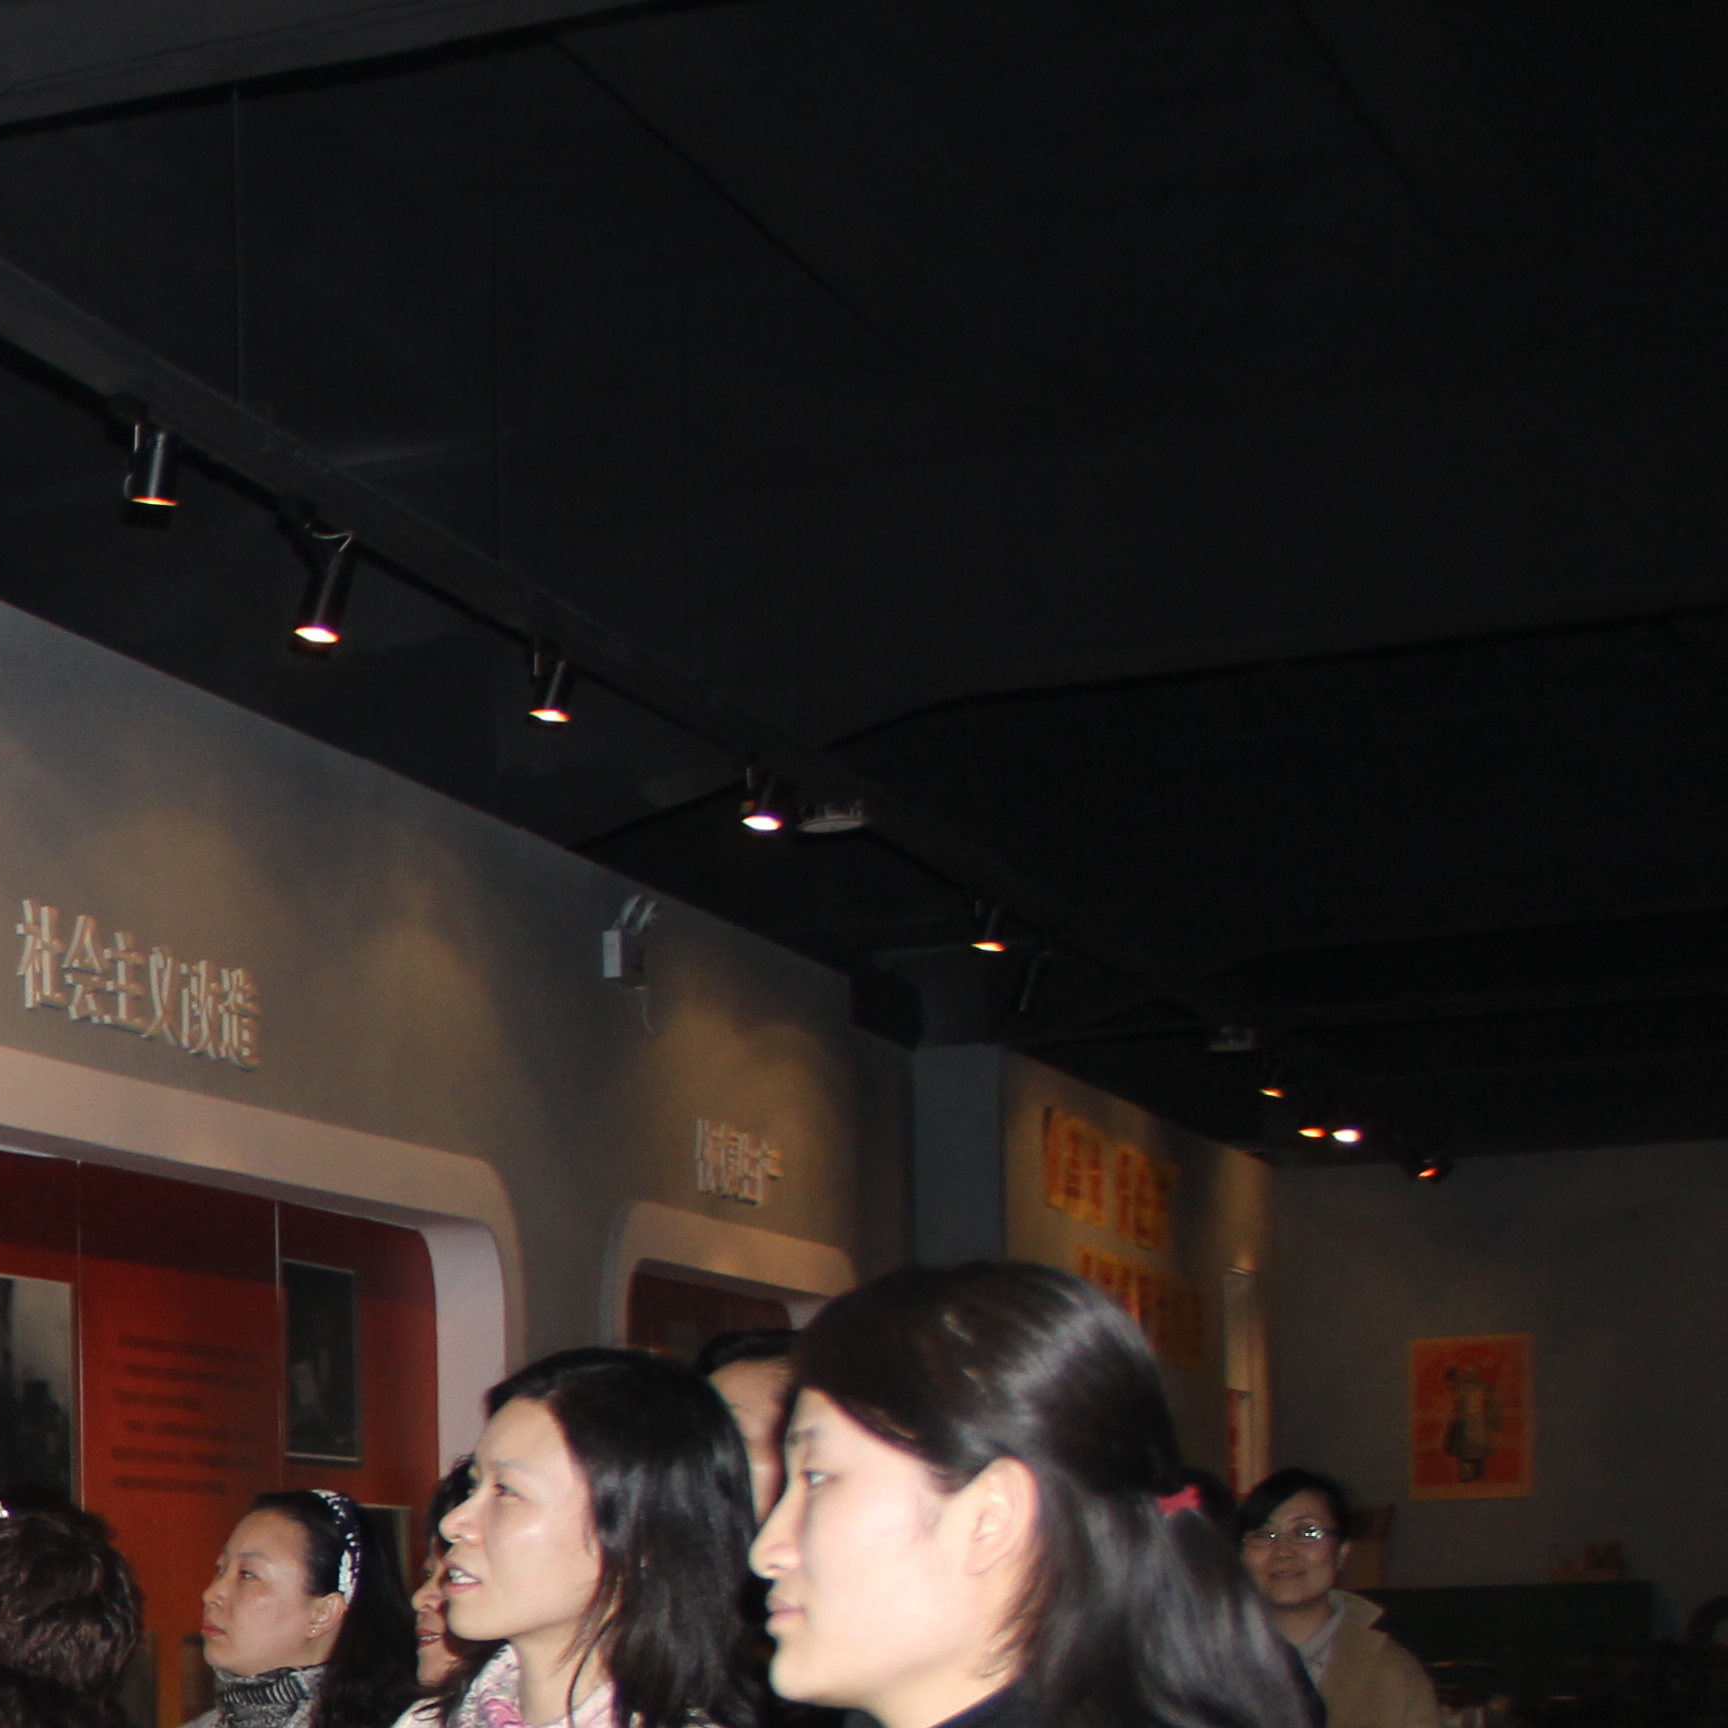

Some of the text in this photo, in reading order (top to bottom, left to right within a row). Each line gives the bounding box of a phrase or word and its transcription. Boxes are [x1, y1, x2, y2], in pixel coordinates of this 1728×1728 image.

[16, 898, 262, 1071] 社会主义改造
